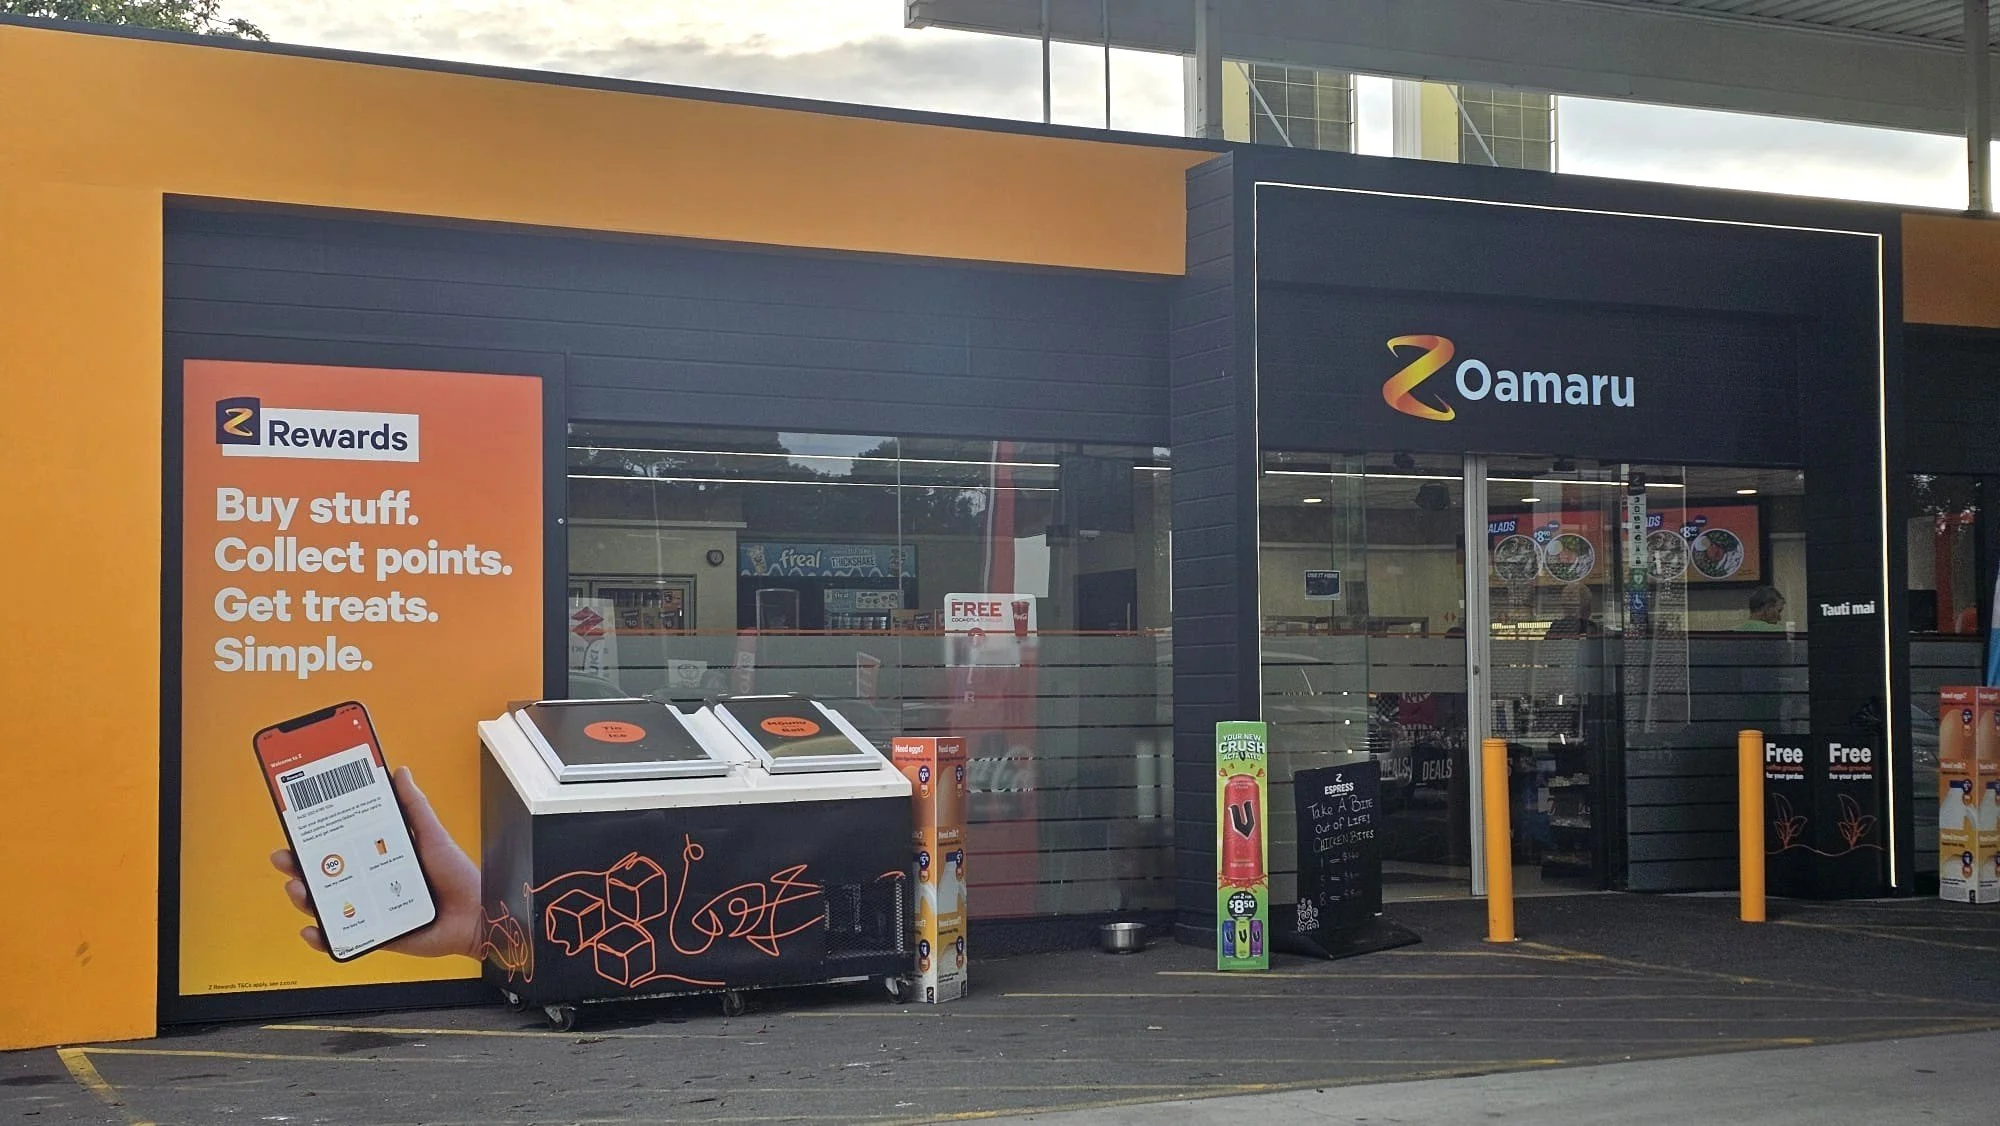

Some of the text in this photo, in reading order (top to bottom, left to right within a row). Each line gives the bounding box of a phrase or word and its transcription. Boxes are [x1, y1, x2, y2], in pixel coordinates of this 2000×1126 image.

[1455, 358, 1635, 408] Oamaru
[268, 419, 409, 452] Rewards
[216, 487, 419, 531] Buy stuff.
[214, 535, 513, 582] Collect points.
[214, 586, 439, 624] Get treats.
[951, 601, 1002, 617] FREE
[1820, 600, 1875, 617] Tauti mai
[214, 635, 373, 680] Simple.
[1218, 740, 1266, 754] CRUSH
[1223, 733, 1261, 741] YOUR NEW
[895, 744, 924, 755] Need eggs?
[1765, 742, 1804, 763] Free
[1829, 742, 1872, 763] Free
[1422, 758, 1453, 781] DEALS
[1324, 782, 1354, 796] ESPRESS
[1306, 801, 1334, 821] Take
[1338, 797, 1347, 813] A
